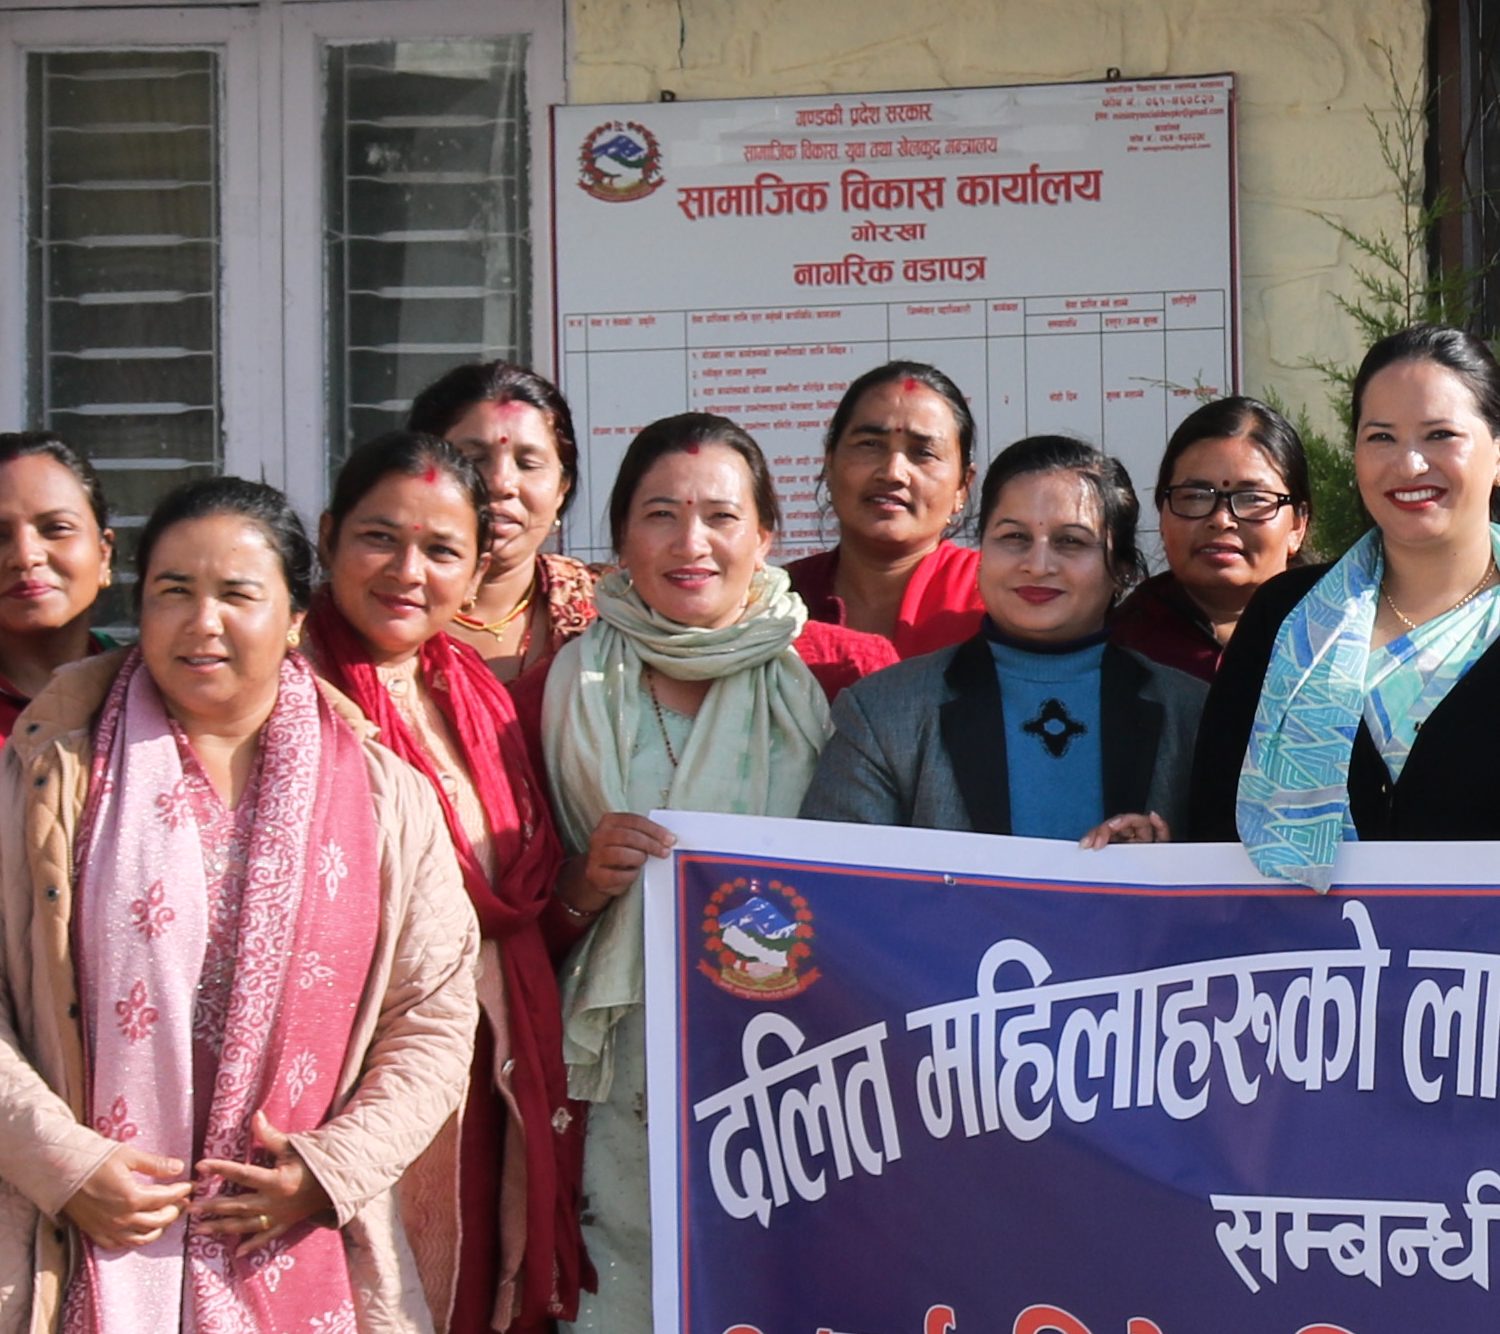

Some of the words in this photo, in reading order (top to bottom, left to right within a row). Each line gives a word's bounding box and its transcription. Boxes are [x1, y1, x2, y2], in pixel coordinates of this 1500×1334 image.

[796, 103, 843, 127] गण्डकी
[850, 103, 881, 127] प्रदेश
[886, 103, 932, 124] सरकार
[744, 139, 797, 162] सामाजिक
[846, 141, 866, 163] युवा
[871, 140, 893, 158] तथा
[897, 136, 941, 160] खेलकुद
[945, 136, 998, 156] मन्त्रालय
[678, 171, 831, 221] सामाजिक
[840, 168, 947, 211] विकास
[956, 163, 1104, 207] कार्यालय
[850, 220, 927, 242] गोरखा
[793, 253, 895, 286] नागरिक
[902, 255, 987, 283] वडापत्र
[693, 1011, 902, 1229] दलित
